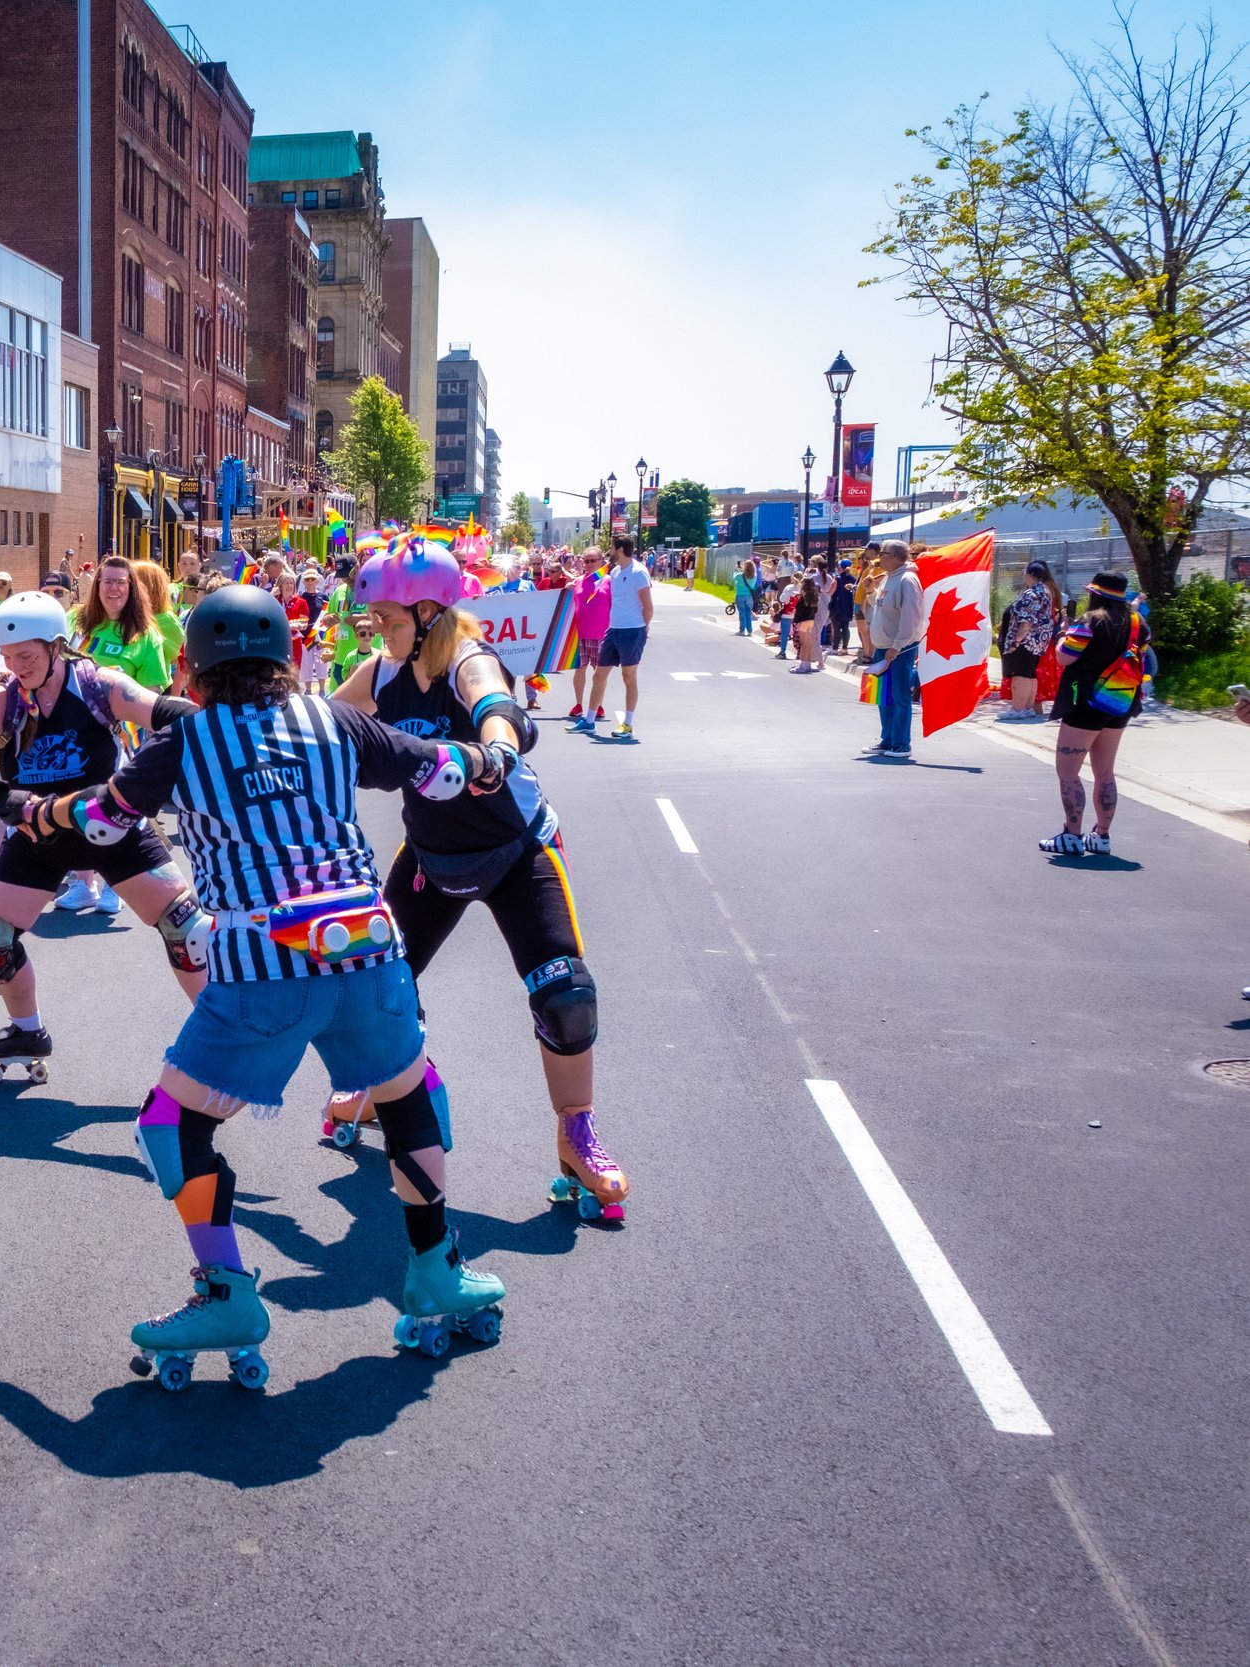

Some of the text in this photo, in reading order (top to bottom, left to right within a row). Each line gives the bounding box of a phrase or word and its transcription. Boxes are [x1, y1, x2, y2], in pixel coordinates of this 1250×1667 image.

[105, 642, 123, 655] TD
[499, 645, 537, 656] Brunswick
[33, 736, 55, 752] CITY
[18, 773, 55, 785] ROLLERS
[410, 761, 429, 784] 187
[243, 766, 304, 798] CLUTCH
[173, 900, 192, 920] 187
[537, 960, 565, 979] 187
